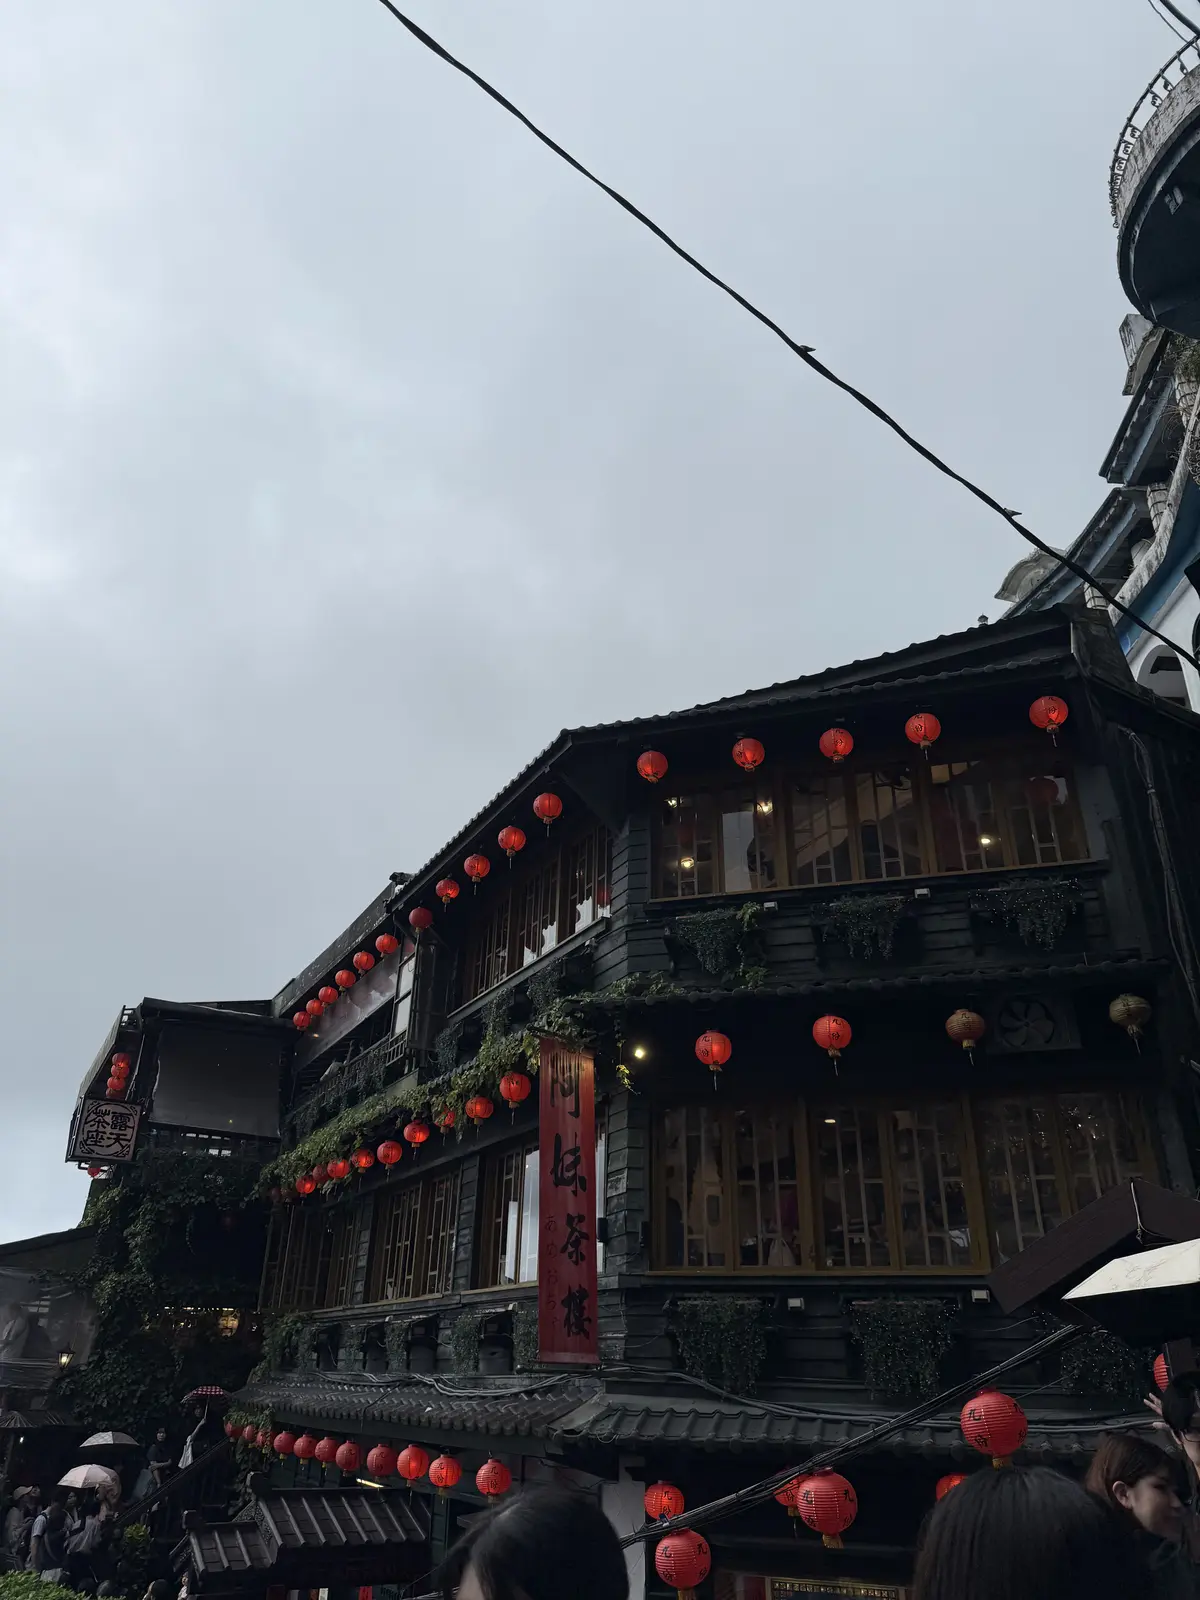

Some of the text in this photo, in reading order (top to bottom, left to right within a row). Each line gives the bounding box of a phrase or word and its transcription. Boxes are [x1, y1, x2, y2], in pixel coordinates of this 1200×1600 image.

[831, 1018, 843, 1041] 九份
[701, 1035, 712, 1057] 九份
[968, 1408, 989, 1449] 九份
[489, 1466, 500, 1490] 九份
